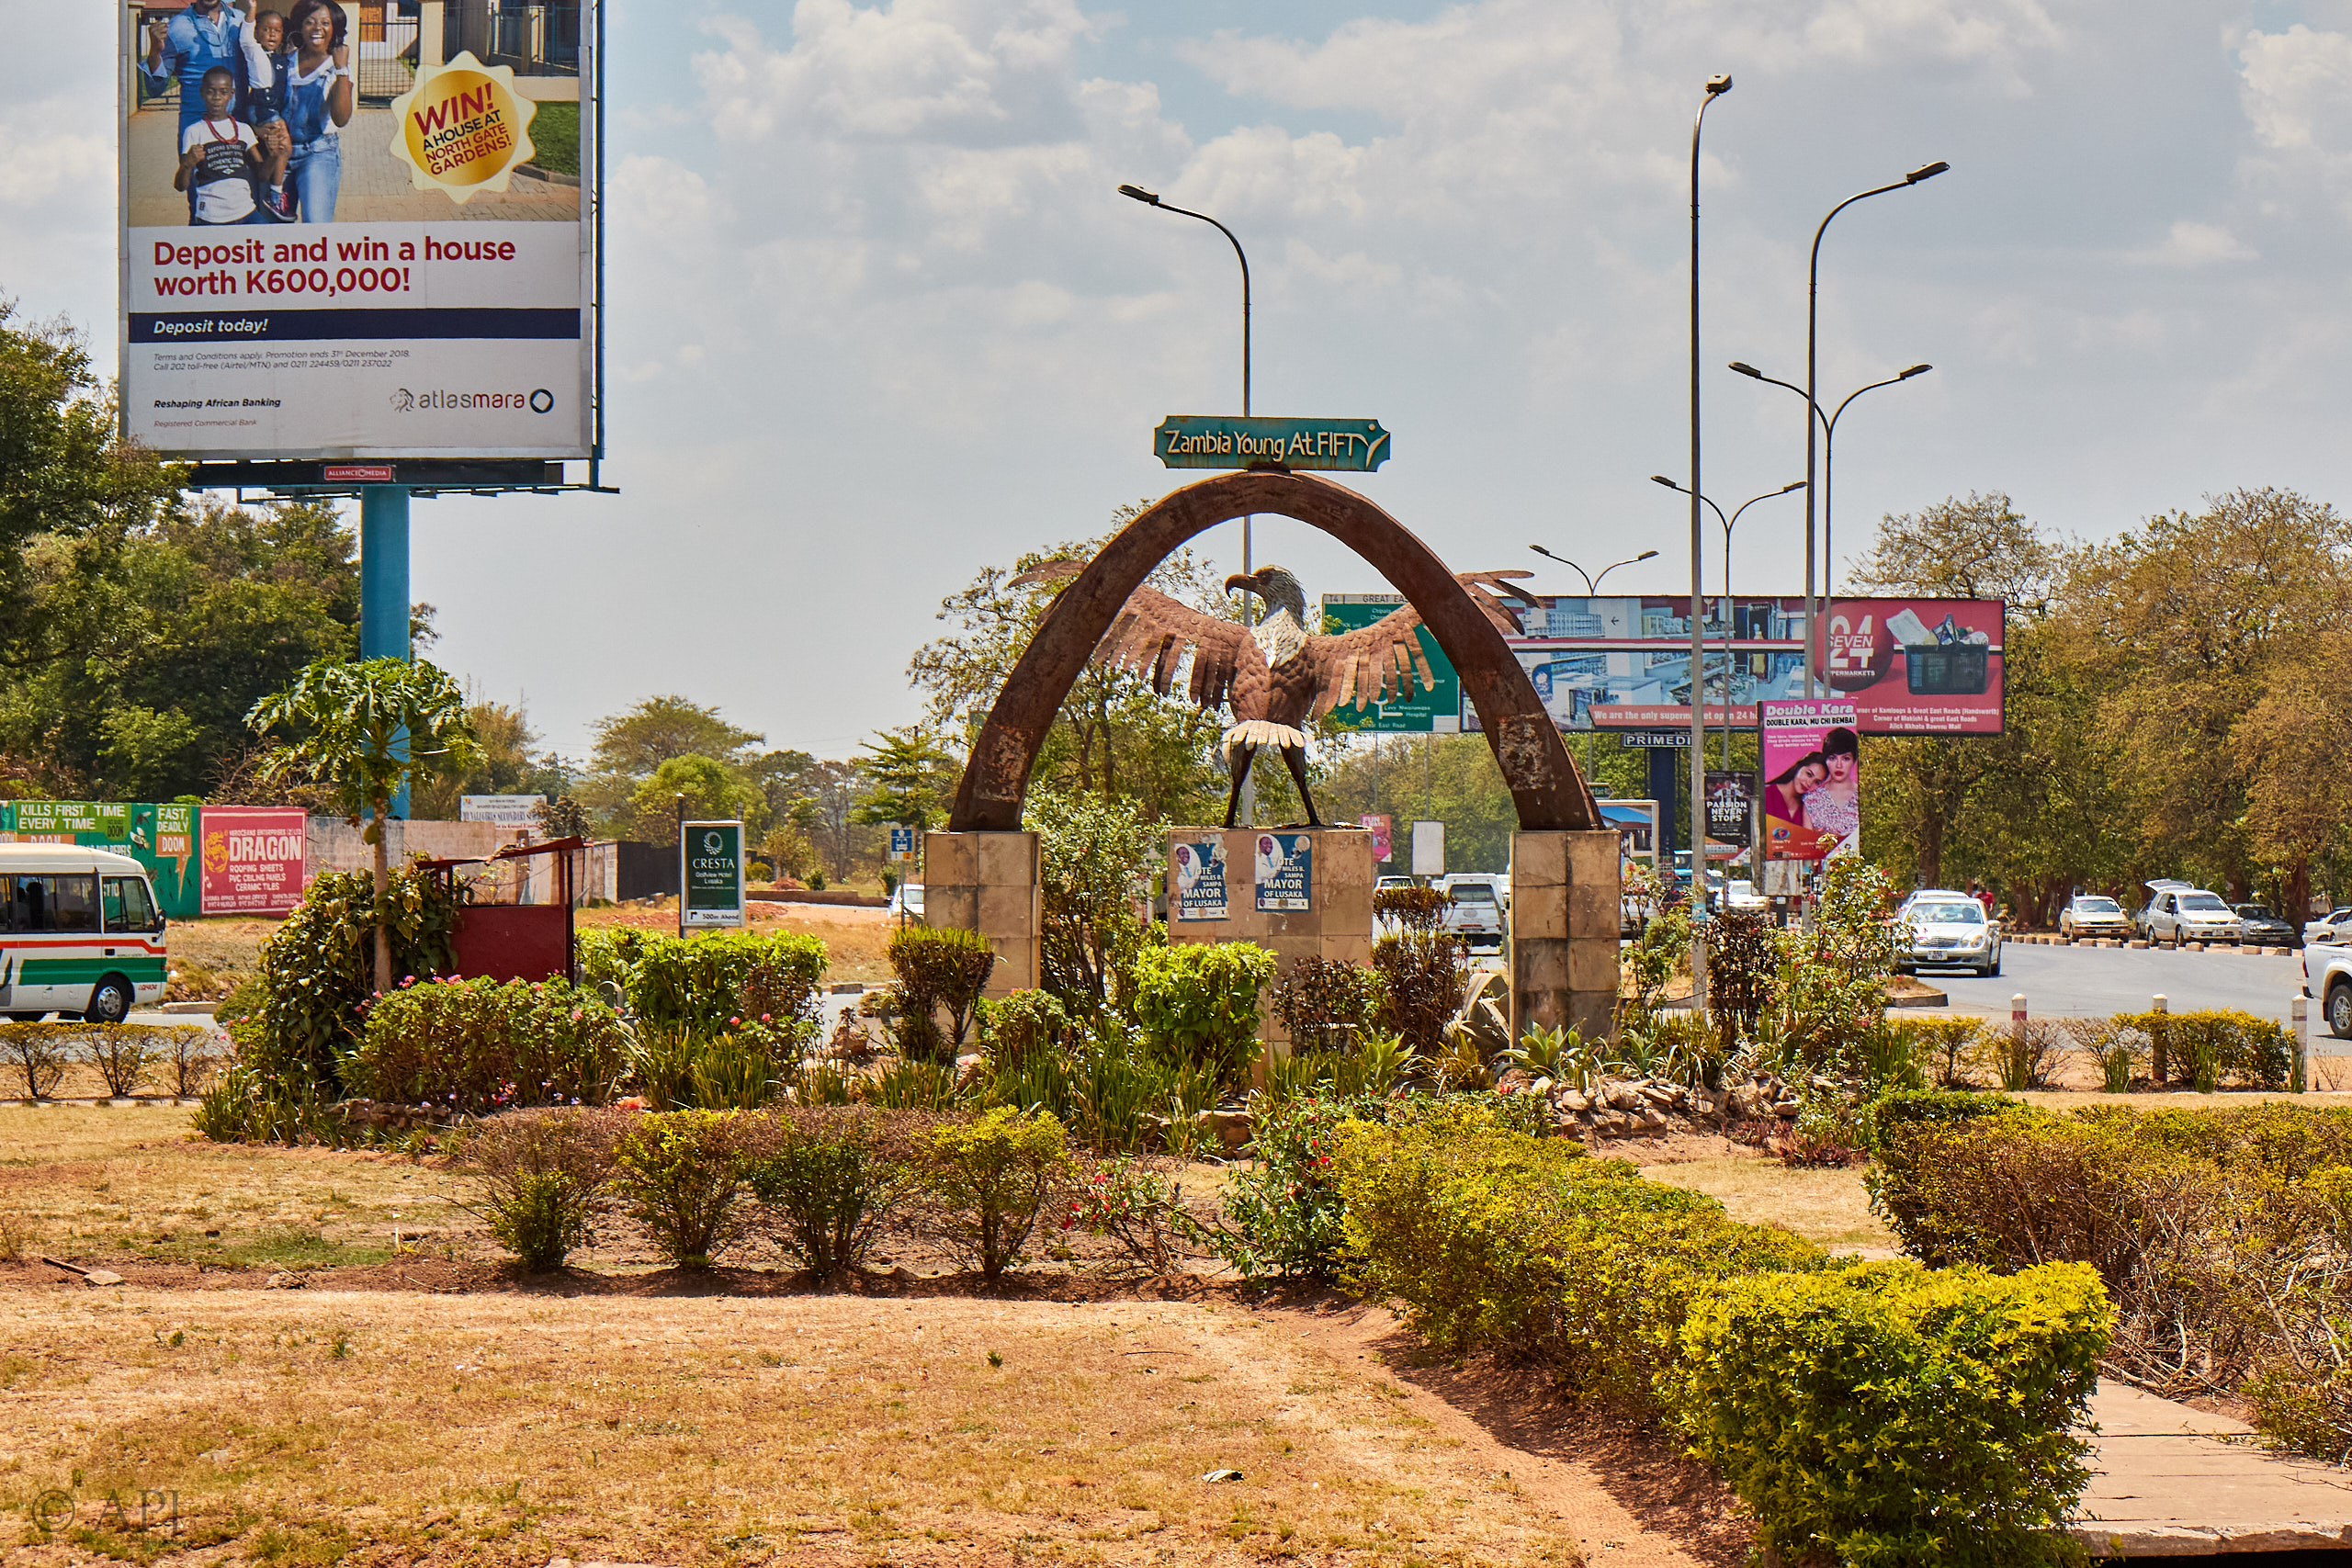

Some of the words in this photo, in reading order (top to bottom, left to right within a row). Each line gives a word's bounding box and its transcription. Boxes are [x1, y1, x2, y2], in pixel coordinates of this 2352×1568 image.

[413, 82, 494, 136] WIN!
[424, 139, 434, 152] A
[433, 118, 483, 144] HOUSE
[485, 109, 501, 126] AT
[425, 137, 471, 164] NORTH
[473, 122, 508, 143] GATE
[430, 133, 512, 175] GARDENS!
[154, 238, 265, 270] Deposit
[273, 236, 328, 263] and
[336, 235, 389, 261] win
[398, 241, 415, 261] a
[424, 235, 516, 261] house
[154, 269, 237, 296] worth
[246, 266, 410, 297] K600,000!
[153, 319, 213, 336] Deposit
[218, 318, 269, 334] today!
[153, 353, 177, 361] Terms
[178, 353, 194, 361] and
[196, 352, 238, 360] Conditions
[266, 351, 308, 359] Promotion
[310, 350, 329, 358] ends
[345, 350, 387, 358] December
[170, 362, 185, 370] 202
[187, 362, 219, 370] toll-free
[220, 361, 271, 371] (Airtel/MTN)
[273, 361, 288, 369] and
[290, 360, 308, 368] 0211
[153, 399, 203, 410] Reshaping
[205, 399, 240, 408] African
[242, 398, 281, 409] Banking
[419, 389, 525, 409] atlasmara
[153, 419, 193, 429] Registered
[194, 418, 237, 428] Commercial
[239, 418, 257, 426] Bank
[1164, 429, 1232, 455] Zambia
[1234, 430, 1285, 463] Young
[1288, 431, 1317, 456] At
[1317, 432, 1391, 468] FIFTY
[1329, 594, 1339, 603] T4
[1363, 594, 1390, 603] GREAT
[1593, 710, 1608, 719] We
[1624, 711, 1639, 719] the
[1641, 711, 1657, 721] only
[1713, 712, 1735, 720] opn
[1736, 711, 1747, 719] 24
[1766, 705, 1816, 716] Double
[1820, 703, 1854, 715] Kara
[1766, 718, 1790, 727] DOUBLE
[1790, 717, 1809, 726] KARA,
[1832, 716, 1855, 725] BEMBA!
[1626, 736, 1691, 745] PRIMEDI
[20, 804, 51, 817] KILLS
[55, 804, 85, 817] FIRST
[93, 805, 126, 818] TIME
[157, 807, 189, 821] FAST,
[18, 818, 57, 829] EVERY
[62, 818, 96, 829] TIME
[156, 821, 189, 833] DEADLY
[107, 825, 124, 838] DOOM
[161, 836, 186, 852] DOOM
[229, 836, 302, 862] DRAGON
[692, 858, 735, 869] CRESTA
[1279, 857, 1295, 866] OTE
[229, 863, 257, 873] ROOFING
[260, 863, 284, 873] SHEETS
[229, 873, 242, 883] PVC
[243, 873, 265, 883] CEILING
[266, 872, 287, 882] PANELS
[235, 882, 262, 892] CERAMIC
[263, 882, 280, 891] TILES
[1264, 879, 1303, 889] MAYOR
[1182, 887, 1222, 899] MAYOR
[1264, 890, 1275, 898] OF
[1275, 890, 1304, 898] LUSAKA
[1183, 900, 1193, 908] OF
[1194, 899, 1223, 908] LUSAKA
